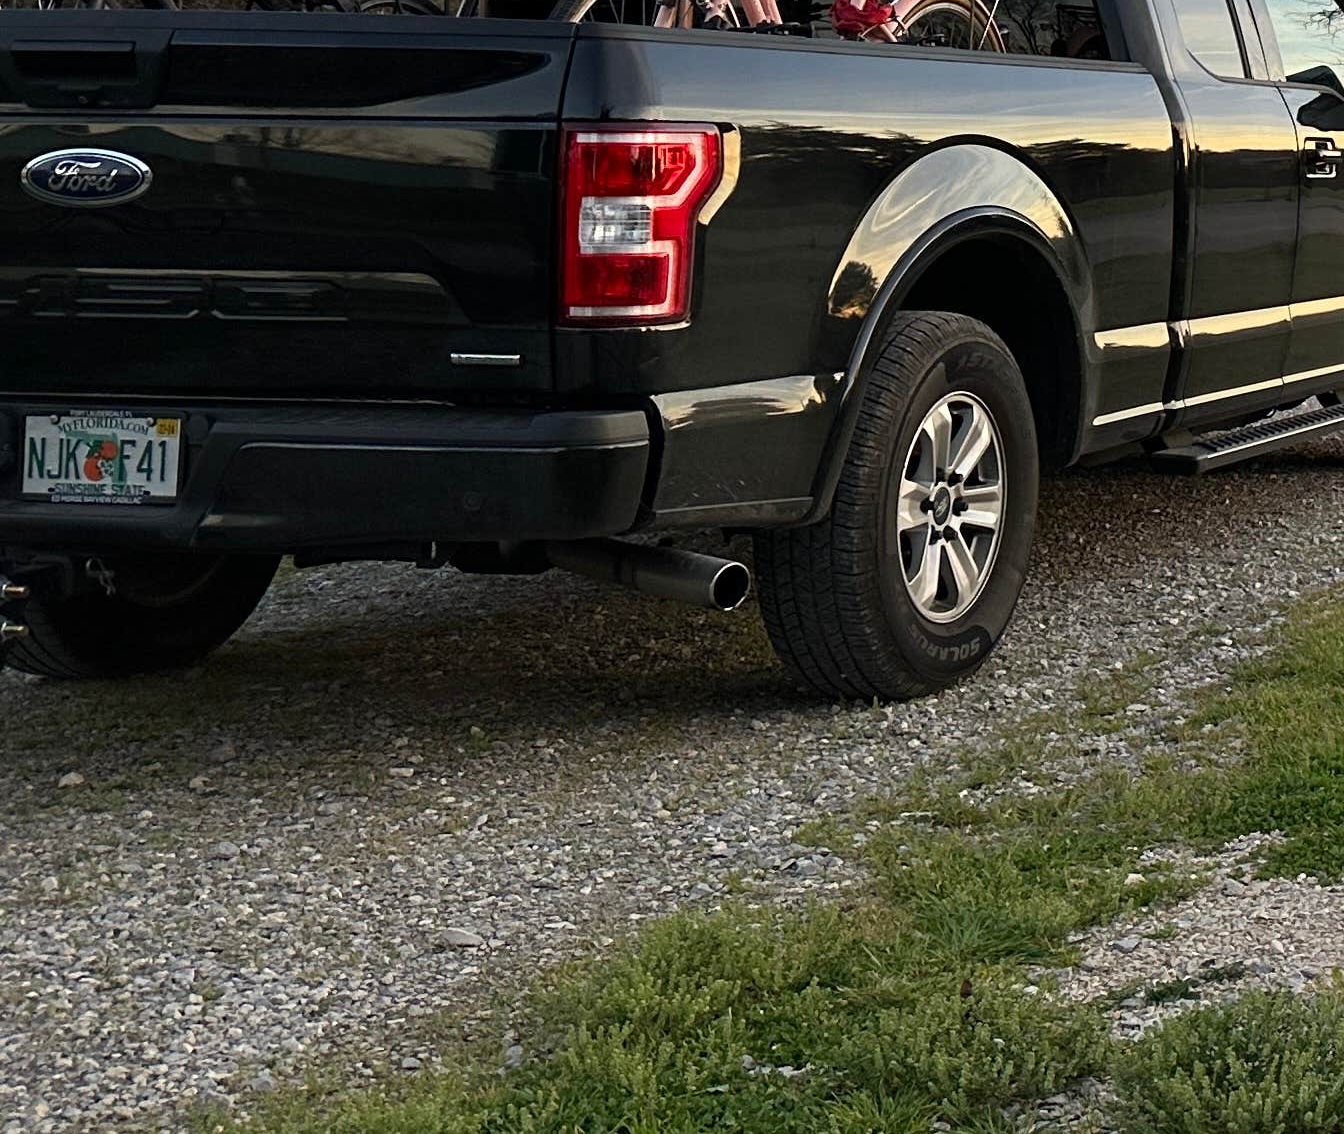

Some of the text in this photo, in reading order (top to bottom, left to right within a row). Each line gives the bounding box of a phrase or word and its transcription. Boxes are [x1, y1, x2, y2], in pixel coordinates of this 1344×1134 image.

[48, 160, 119, 192] Ford
[54, 482, 145, 497] SUNSHINE STATE
